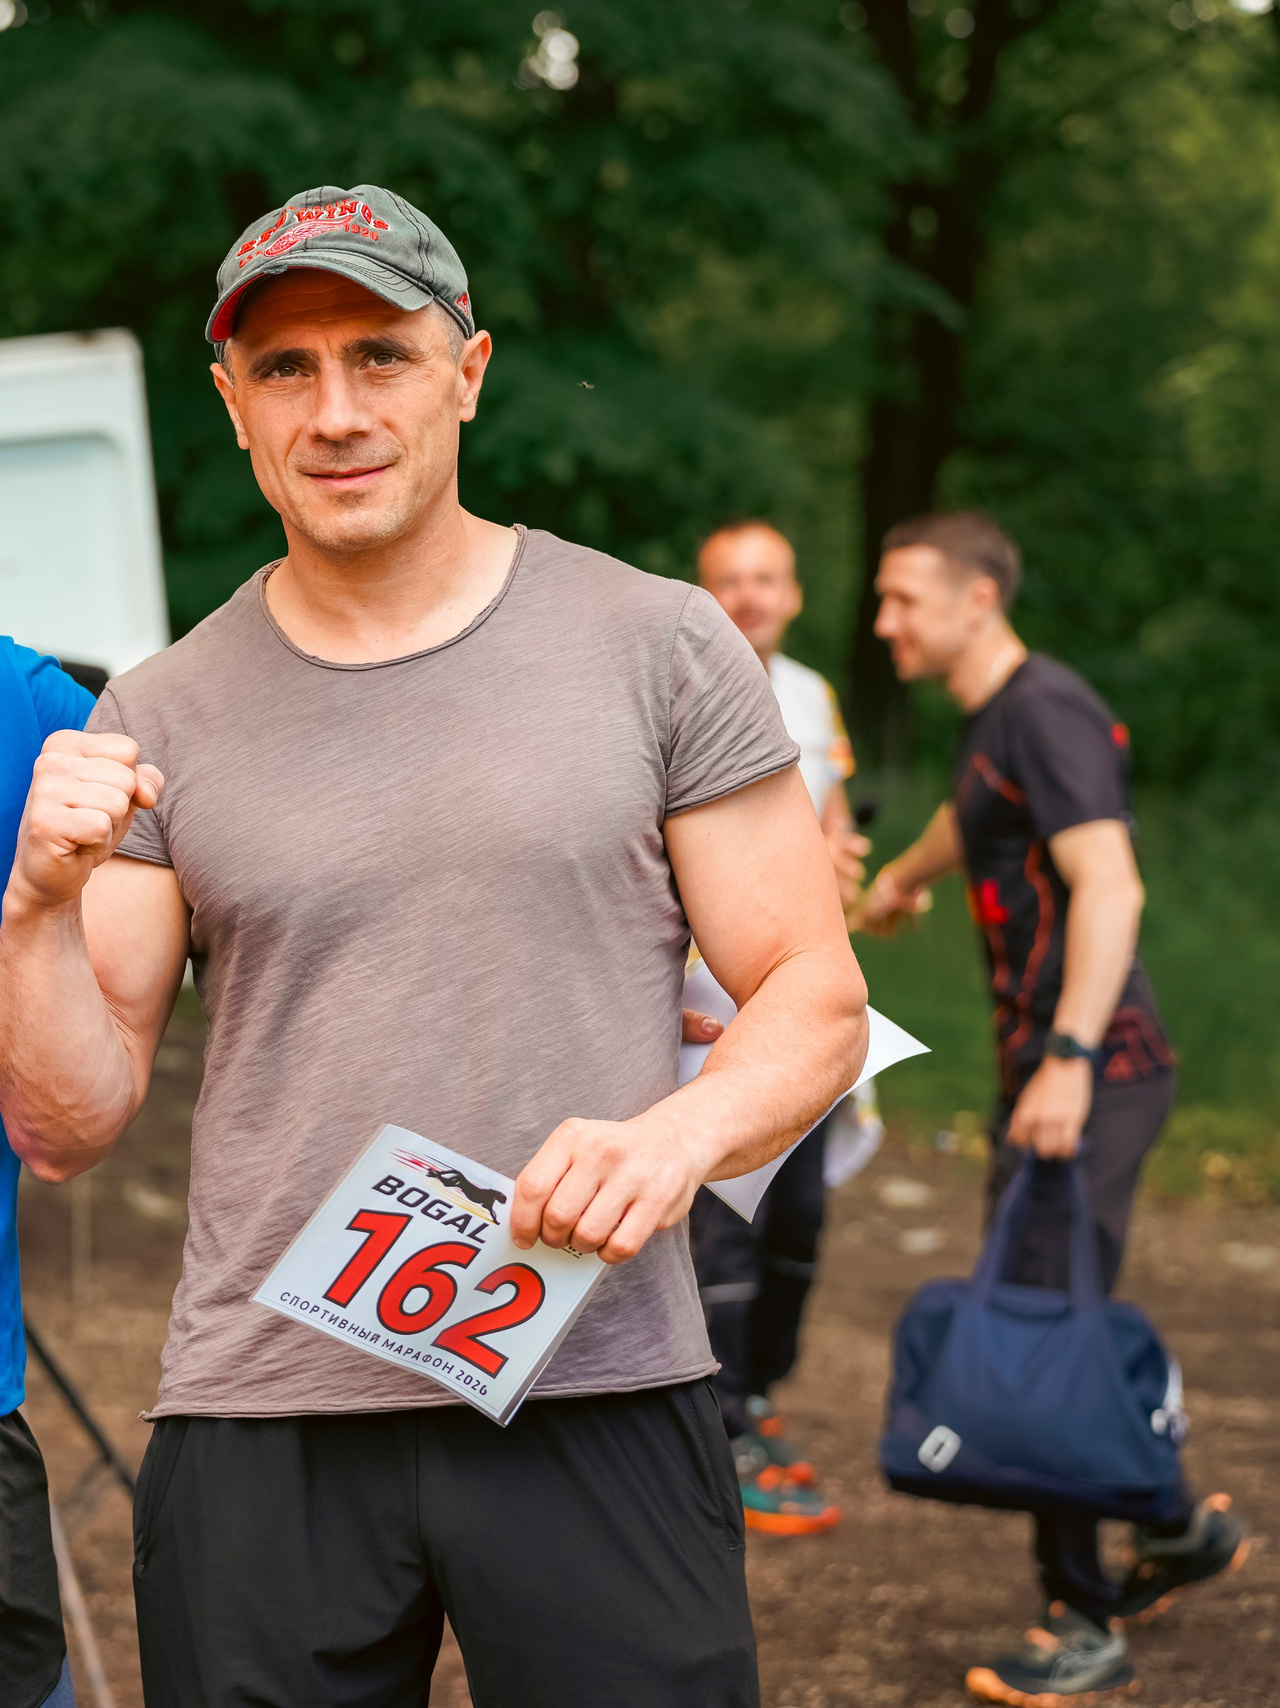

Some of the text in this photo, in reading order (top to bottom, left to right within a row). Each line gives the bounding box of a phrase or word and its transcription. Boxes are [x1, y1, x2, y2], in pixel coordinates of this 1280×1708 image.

[344, 223, 379, 242] 1926
[371, 1174, 491, 1244] BOGAL
[322, 1208, 546, 1380] 162
[279, 1291, 488, 1397] СПОРТИВНЫЙ МАРАФОН 2026
